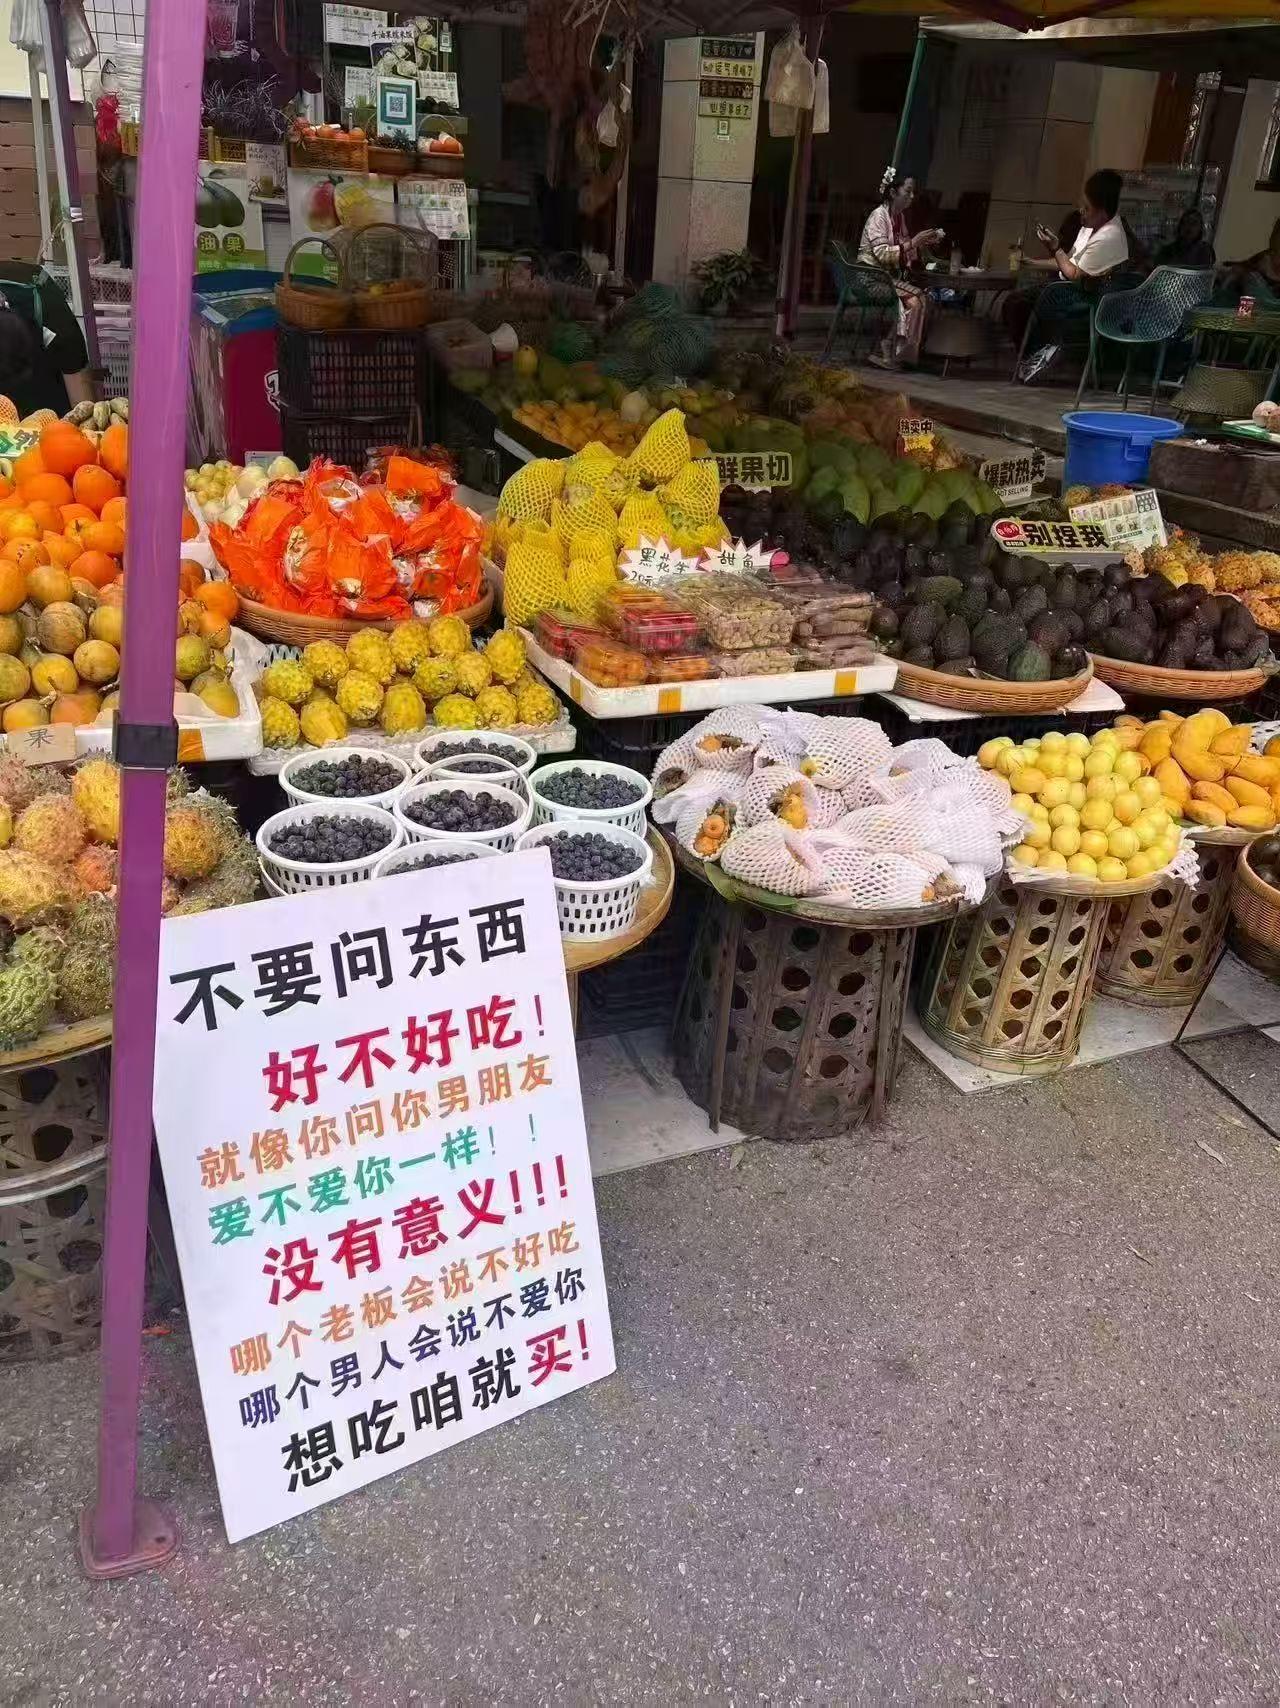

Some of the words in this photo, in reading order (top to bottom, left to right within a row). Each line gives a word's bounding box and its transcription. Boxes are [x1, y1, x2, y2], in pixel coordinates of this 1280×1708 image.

[691, 455, 790, 483] 鲜果切
[1022, 523, 1109, 549] 别捏我
[639, 547, 690, 575] 黑花生
[170, 898, 527, 1032] 不要问东西
[262, 994, 546, 1112] 好不好吃！
[196, 1053, 553, 1190] 就像你问你男朋友
[262, 1154, 570, 1306] 没有意义！！！
[230, 1220, 580, 1376] 哪个老板会说不好吃
[238, 1266, 586, 1430] 哪个男人会说不爱你
[280, 1318, 591, 1493] 想吃咱就买！
